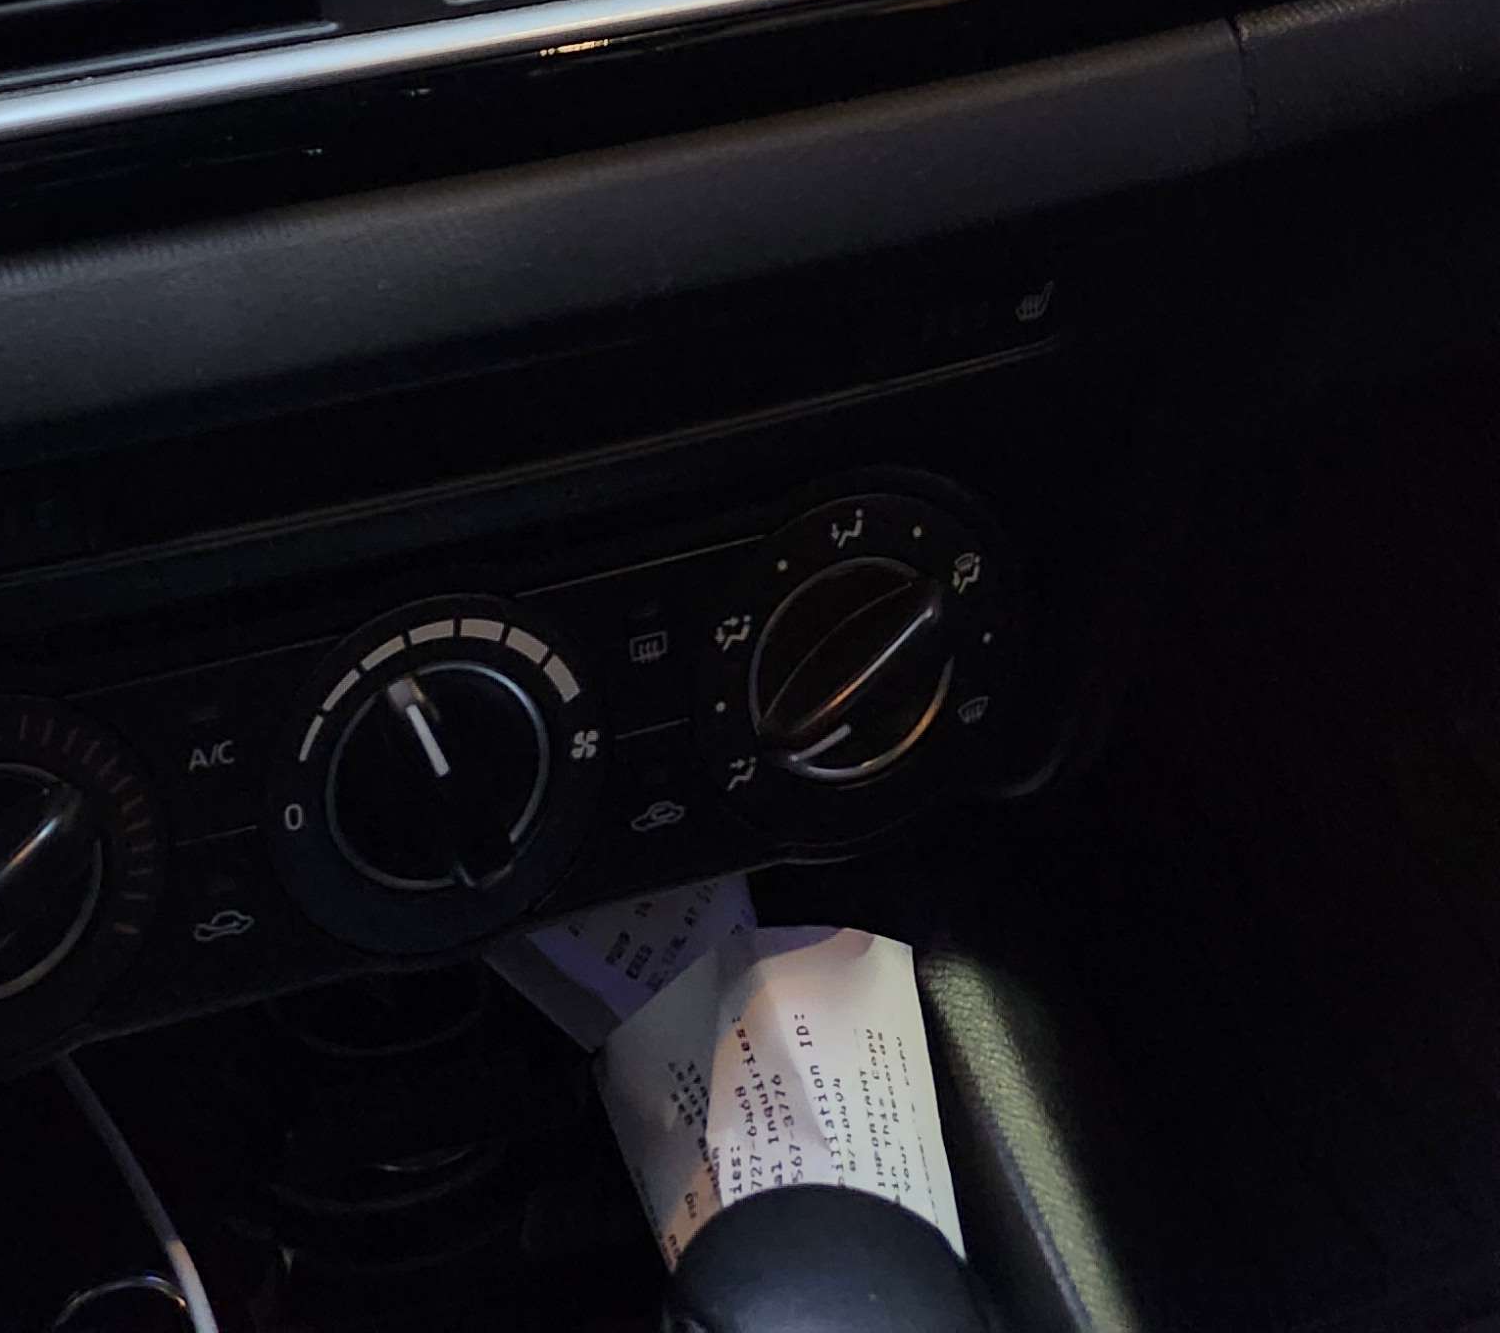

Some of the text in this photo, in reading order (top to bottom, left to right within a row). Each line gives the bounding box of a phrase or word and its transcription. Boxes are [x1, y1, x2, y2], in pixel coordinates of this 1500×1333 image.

[188, 739, 236, 771] A/C
[793, 1012, 812, 1048] ID:
[728, 1145, 743, 1199] ies:
